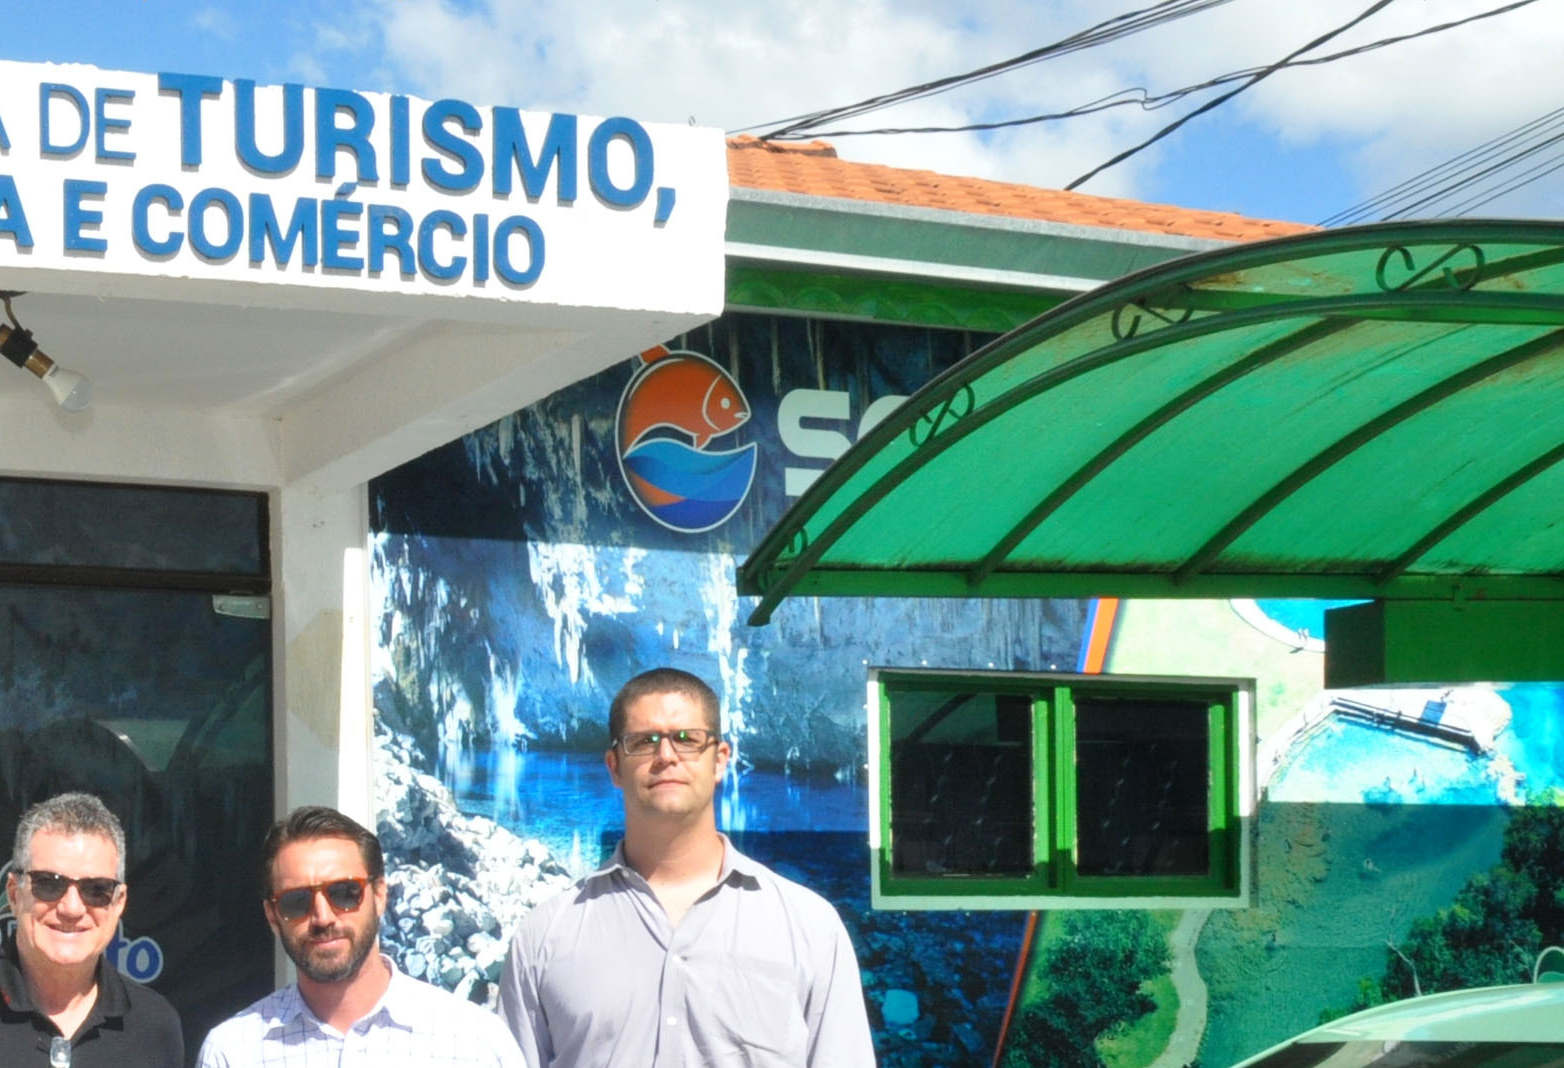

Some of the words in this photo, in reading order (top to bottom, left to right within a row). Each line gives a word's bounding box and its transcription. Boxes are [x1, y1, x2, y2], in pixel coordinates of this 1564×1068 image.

[40, 82, 137, 161] DE
[158, 72, 676, 224] TURISMO,
[63, 178, 108, 252] E
[132, 181, 546, 286] COMÉRCIO
